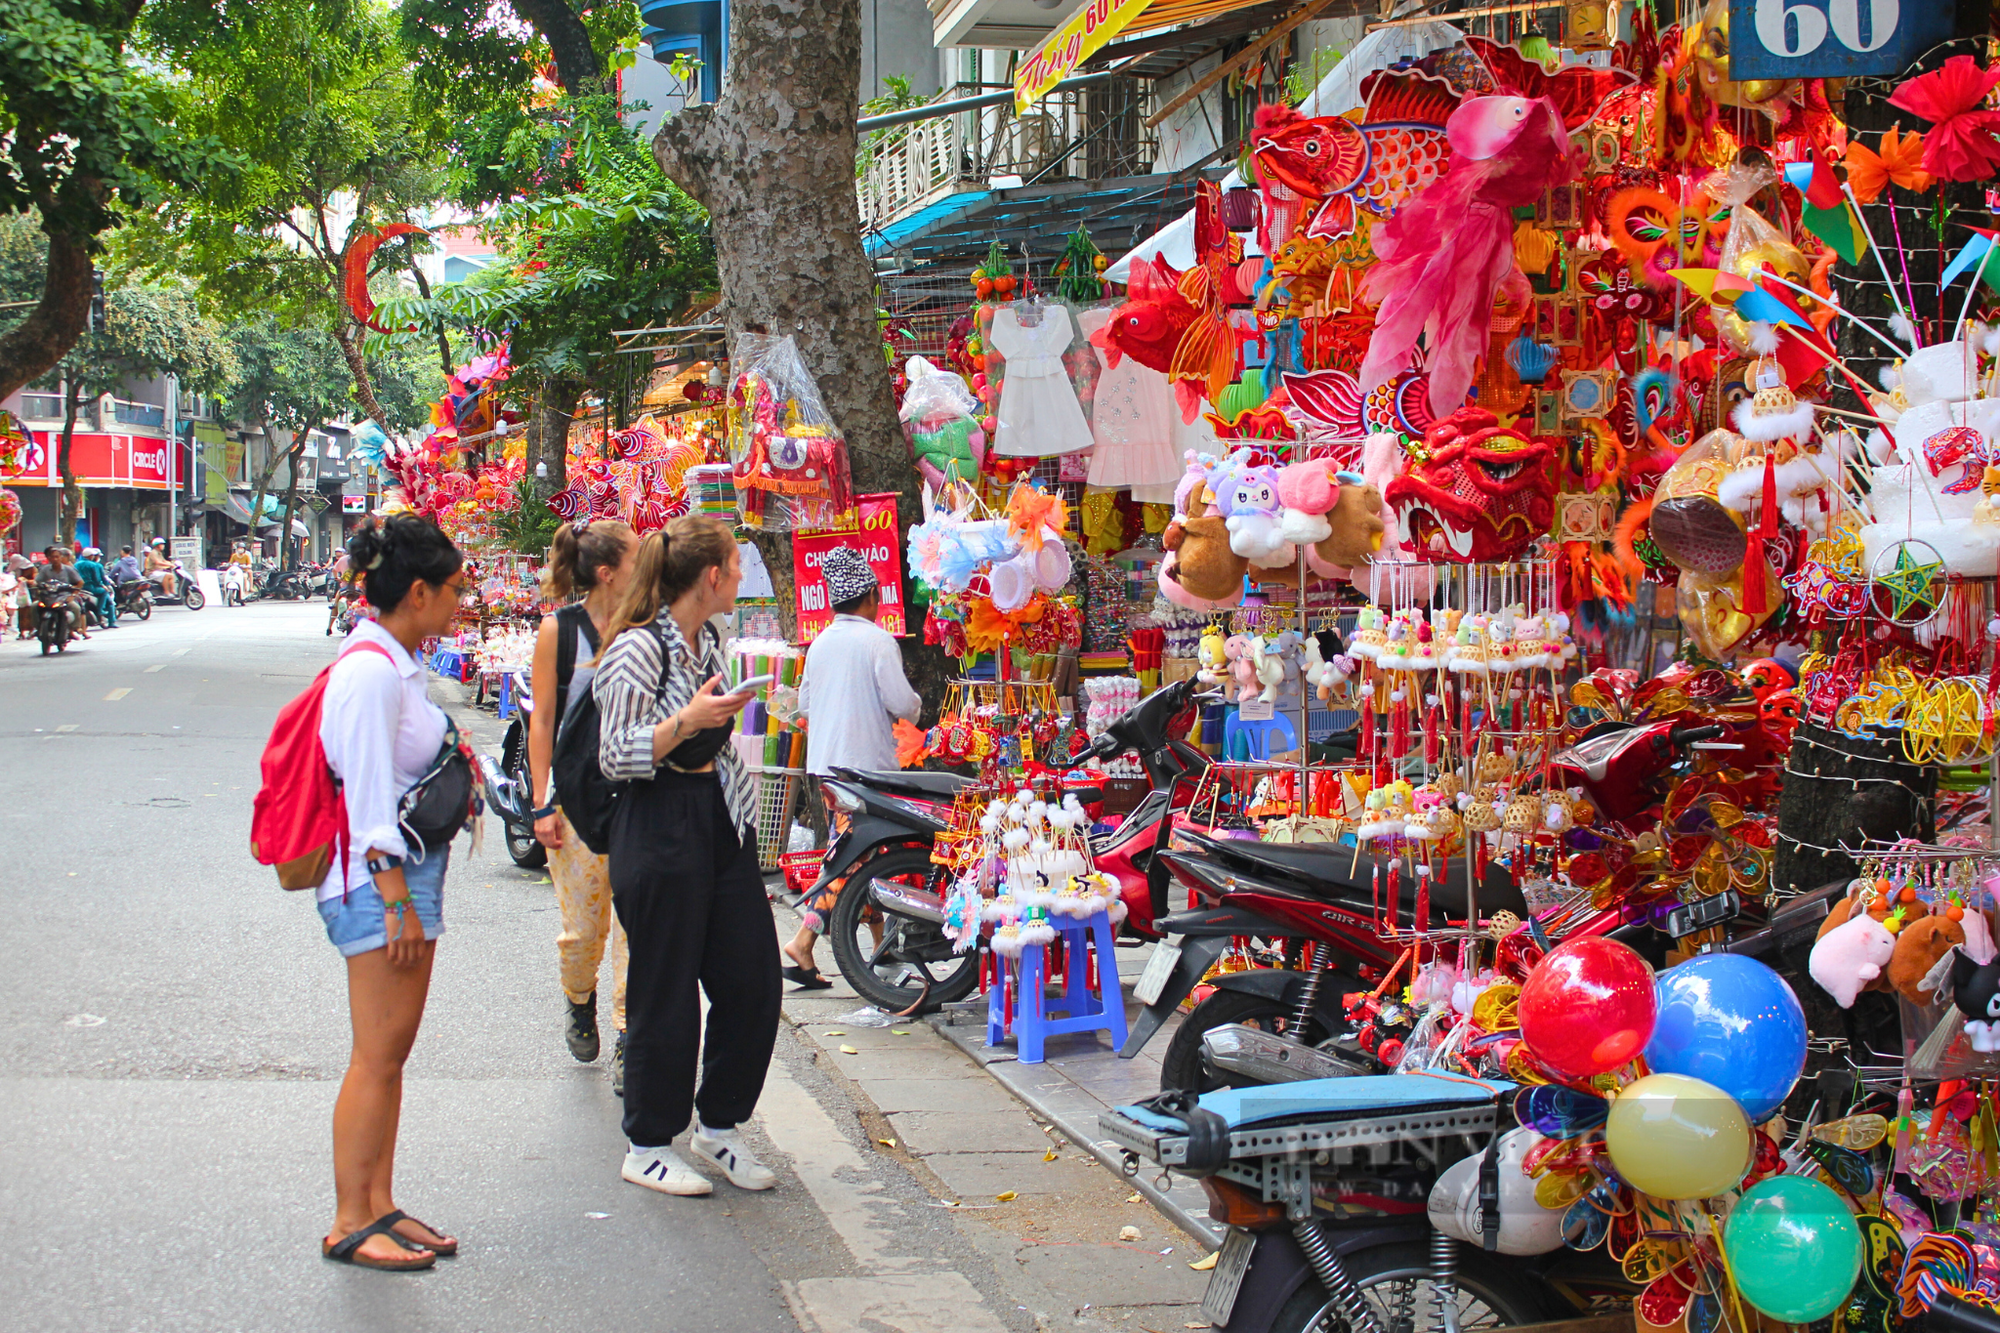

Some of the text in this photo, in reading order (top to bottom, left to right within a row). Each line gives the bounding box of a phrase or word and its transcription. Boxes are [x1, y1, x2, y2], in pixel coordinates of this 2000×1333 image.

[1755, 0, 1899, 57] 60
[1015, 0, 1108, 101] Thúy 60
[133, 452, 155, 468] CIRCLE
[864, 510, 893, 531] 60
[861, 544, 889, 562] VÀO
[801, 580, 825, 611] NGÕ
[881, 582, 898, 605] MÃ
[803, 621, 821, 641] LH:
[1206, 914, 1234, 924] HONDA
